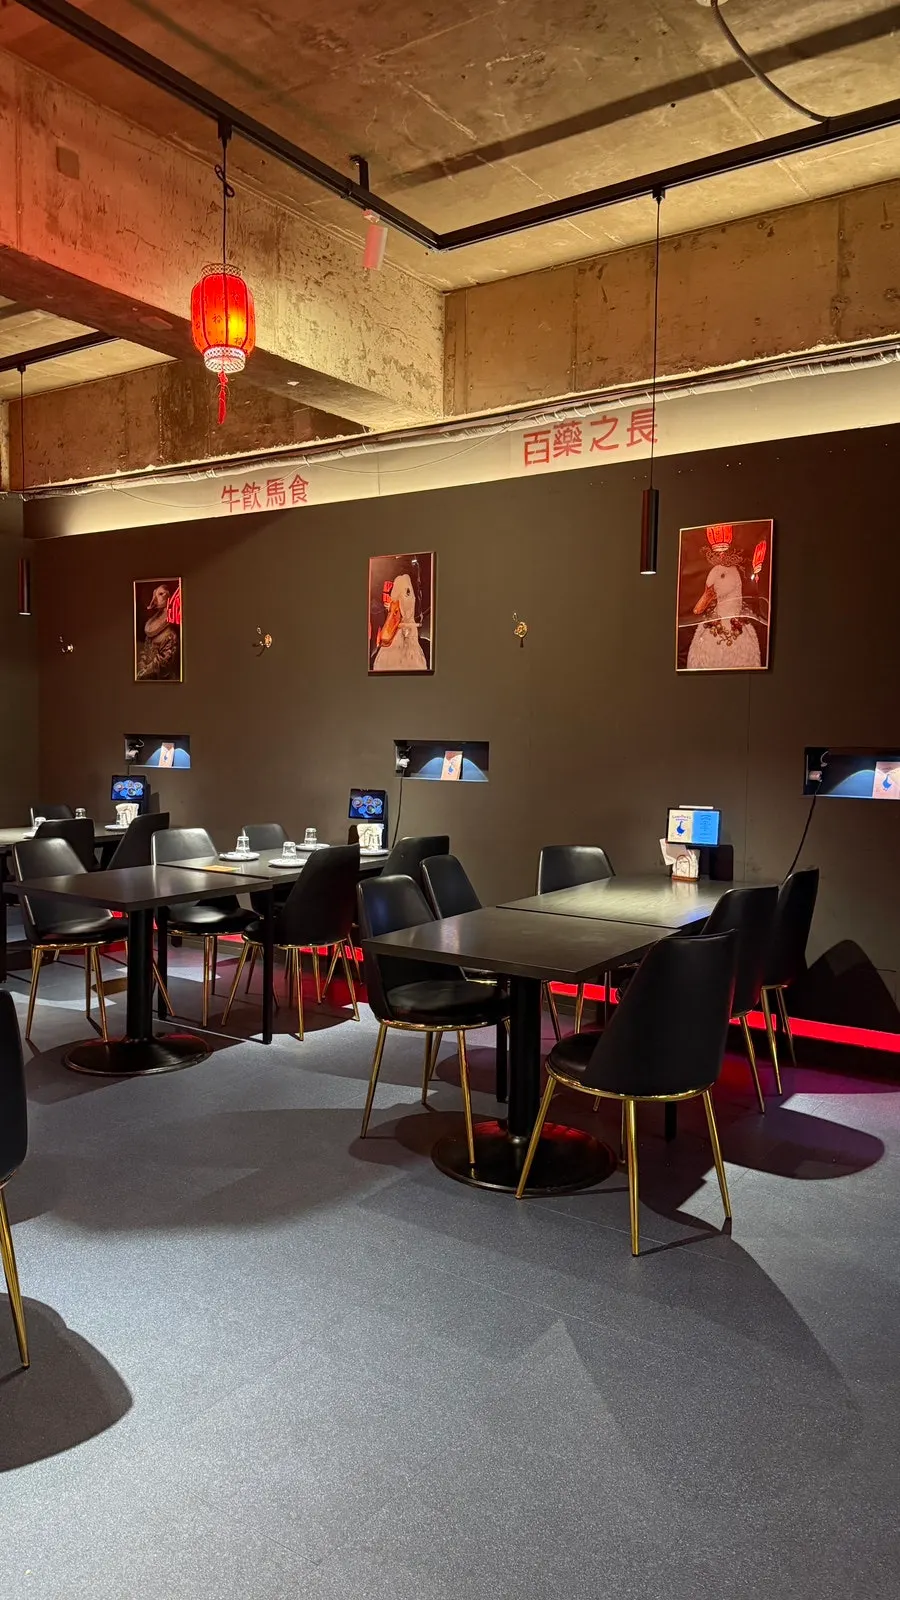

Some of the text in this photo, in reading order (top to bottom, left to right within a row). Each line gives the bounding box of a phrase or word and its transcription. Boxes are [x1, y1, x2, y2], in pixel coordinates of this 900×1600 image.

[523, 408, 658, 467] 百藥之長
[221, 474, 309, 513] 牛飲馬食
